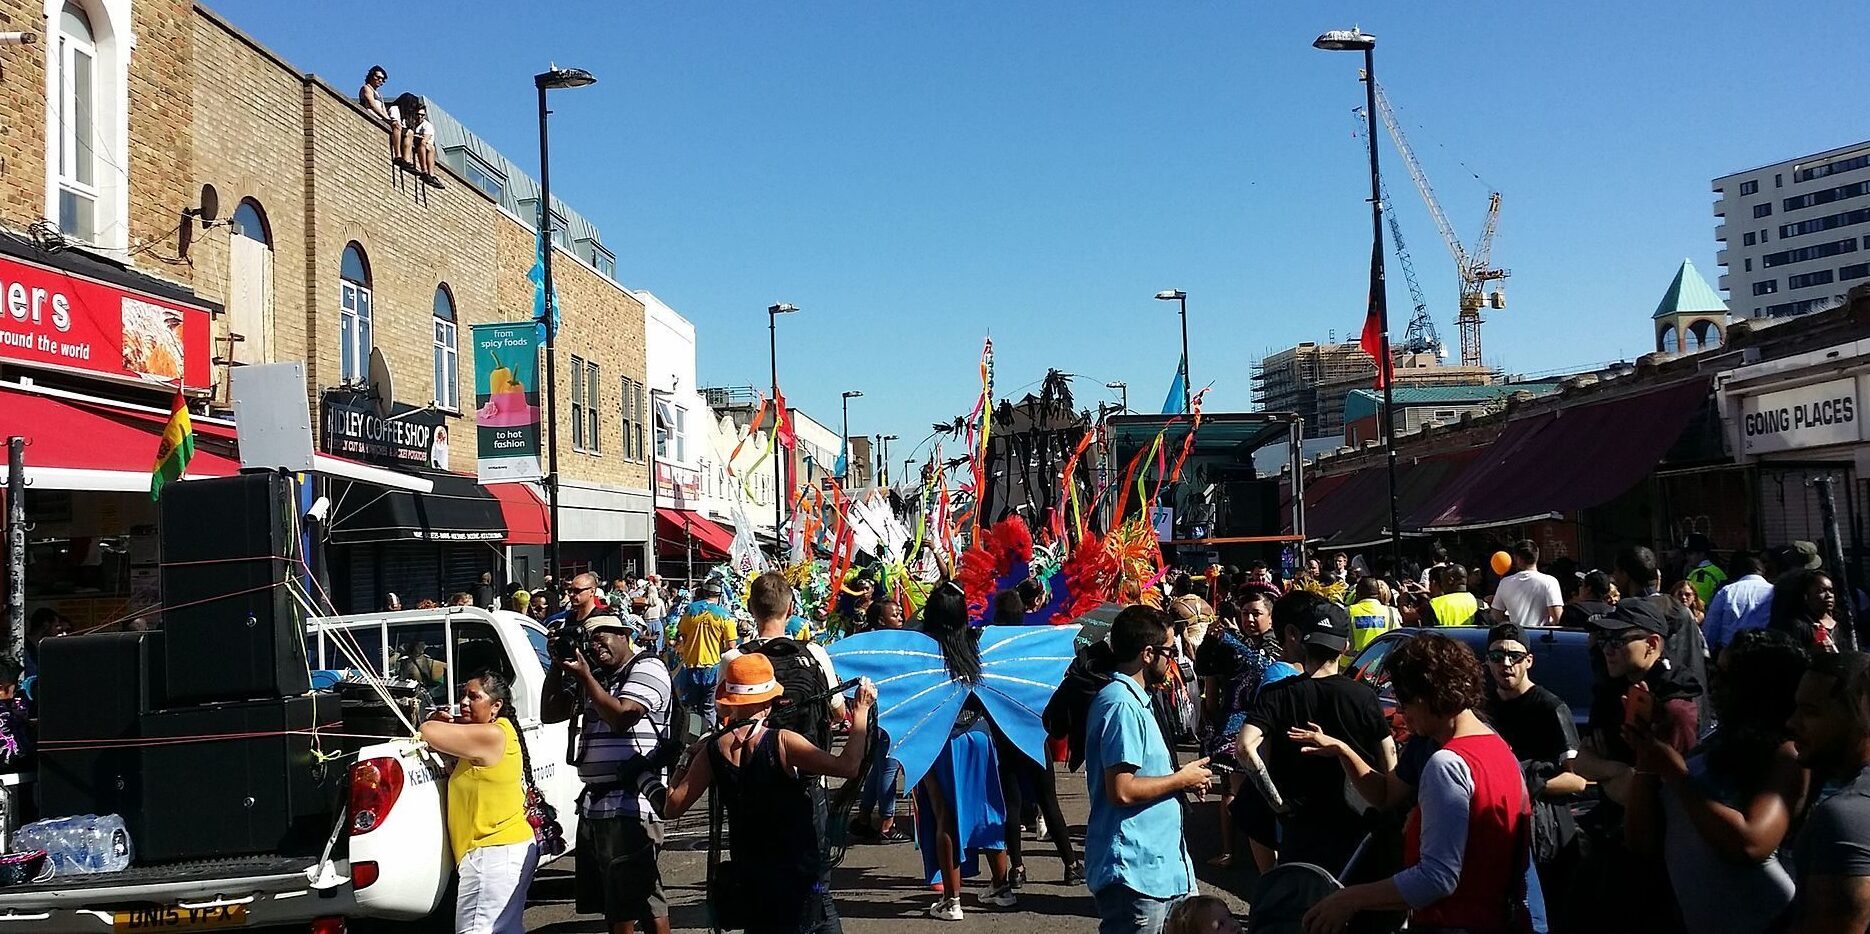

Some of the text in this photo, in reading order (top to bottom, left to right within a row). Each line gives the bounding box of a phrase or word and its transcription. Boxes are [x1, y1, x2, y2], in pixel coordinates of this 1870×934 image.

[494, 330, 514, 338] from
[37, 334, 58, 355] the
[60, 342, 90, 360] world
[481, 337, 528, 349] spicy foods
[1745, 397, 1854, 437] GOING PLACES
[366, 415, 404, 444] COFFEE
[404, 422, 430, 448] SHOP
[496, 430, 523, 439] to hot
[493, 440, 526, 449] fashion
